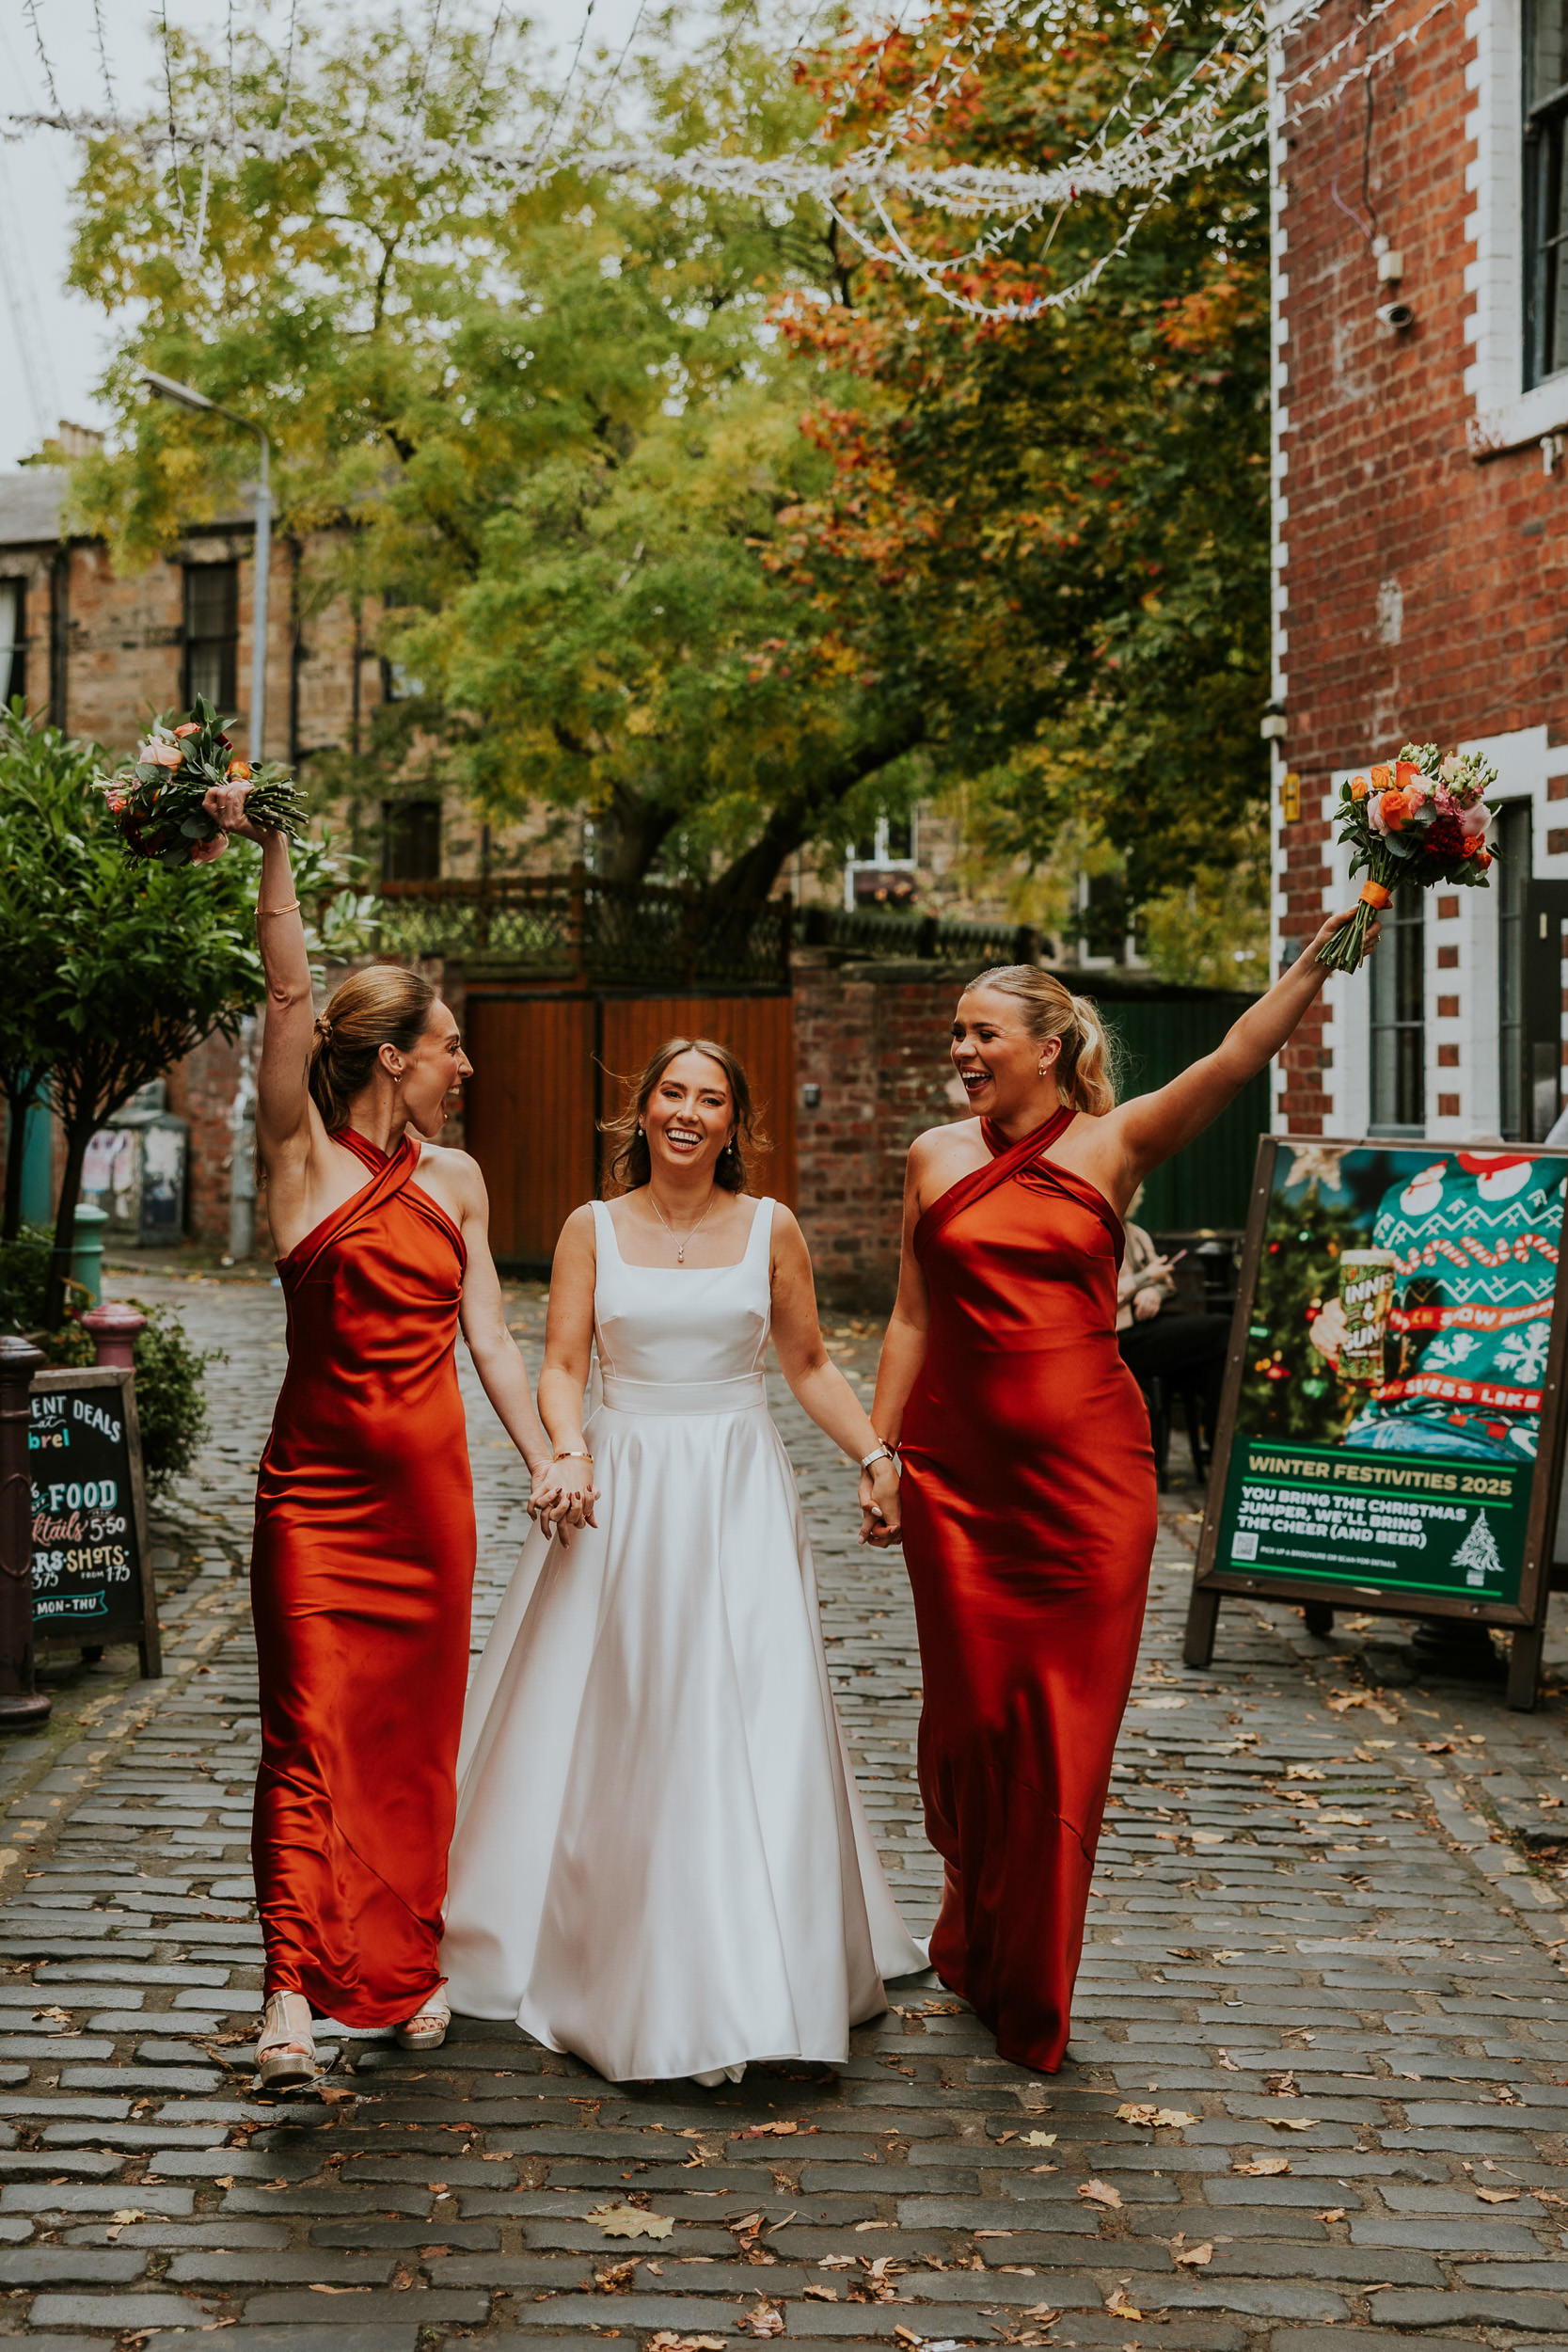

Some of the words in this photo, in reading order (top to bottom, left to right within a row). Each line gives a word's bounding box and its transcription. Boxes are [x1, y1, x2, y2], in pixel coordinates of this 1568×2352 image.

[1363, 1301, 1376, 1321] &
[1481, 1389, 1540, 1409] LIKE
[31, 1395, 67, 1419] ENT
[71, 1399, 121, 1443] DEALS
[28, 1427, 70, 1450] brel
[1248, 1454, 1331, 1478] WINTER
[1333, 1463, 1458, 1491] FESTIVITIES
[1461, 1476, 1513, 1497] 2025
[48, 1480, 118, 1513] FOOD
[1242, 1486, 1276, 1502] YOU
[1278, 1489, 1331, 1508] BRING
[1332, 1495, 1367, 1511] THE
[1368, 1500, 1467, 1522] CHRISTMAS
[31, 1511, 88, 1547] ktails
[1237, 1515, 1271, 1531] THE
[1272, 1518, 1329, 1537] CHEER
[1329, 1523, 1374, 1542] (AND
[1374, 1530, 1428, 1550] BEER)
[1238, 1501, 1312, 1522] JUMPER,
[1315, 1508, 1368, 1527] WE'LL
[1369, 1514, 1423, 1533] BRING
[81, 1571, 104, 1580] FROM
